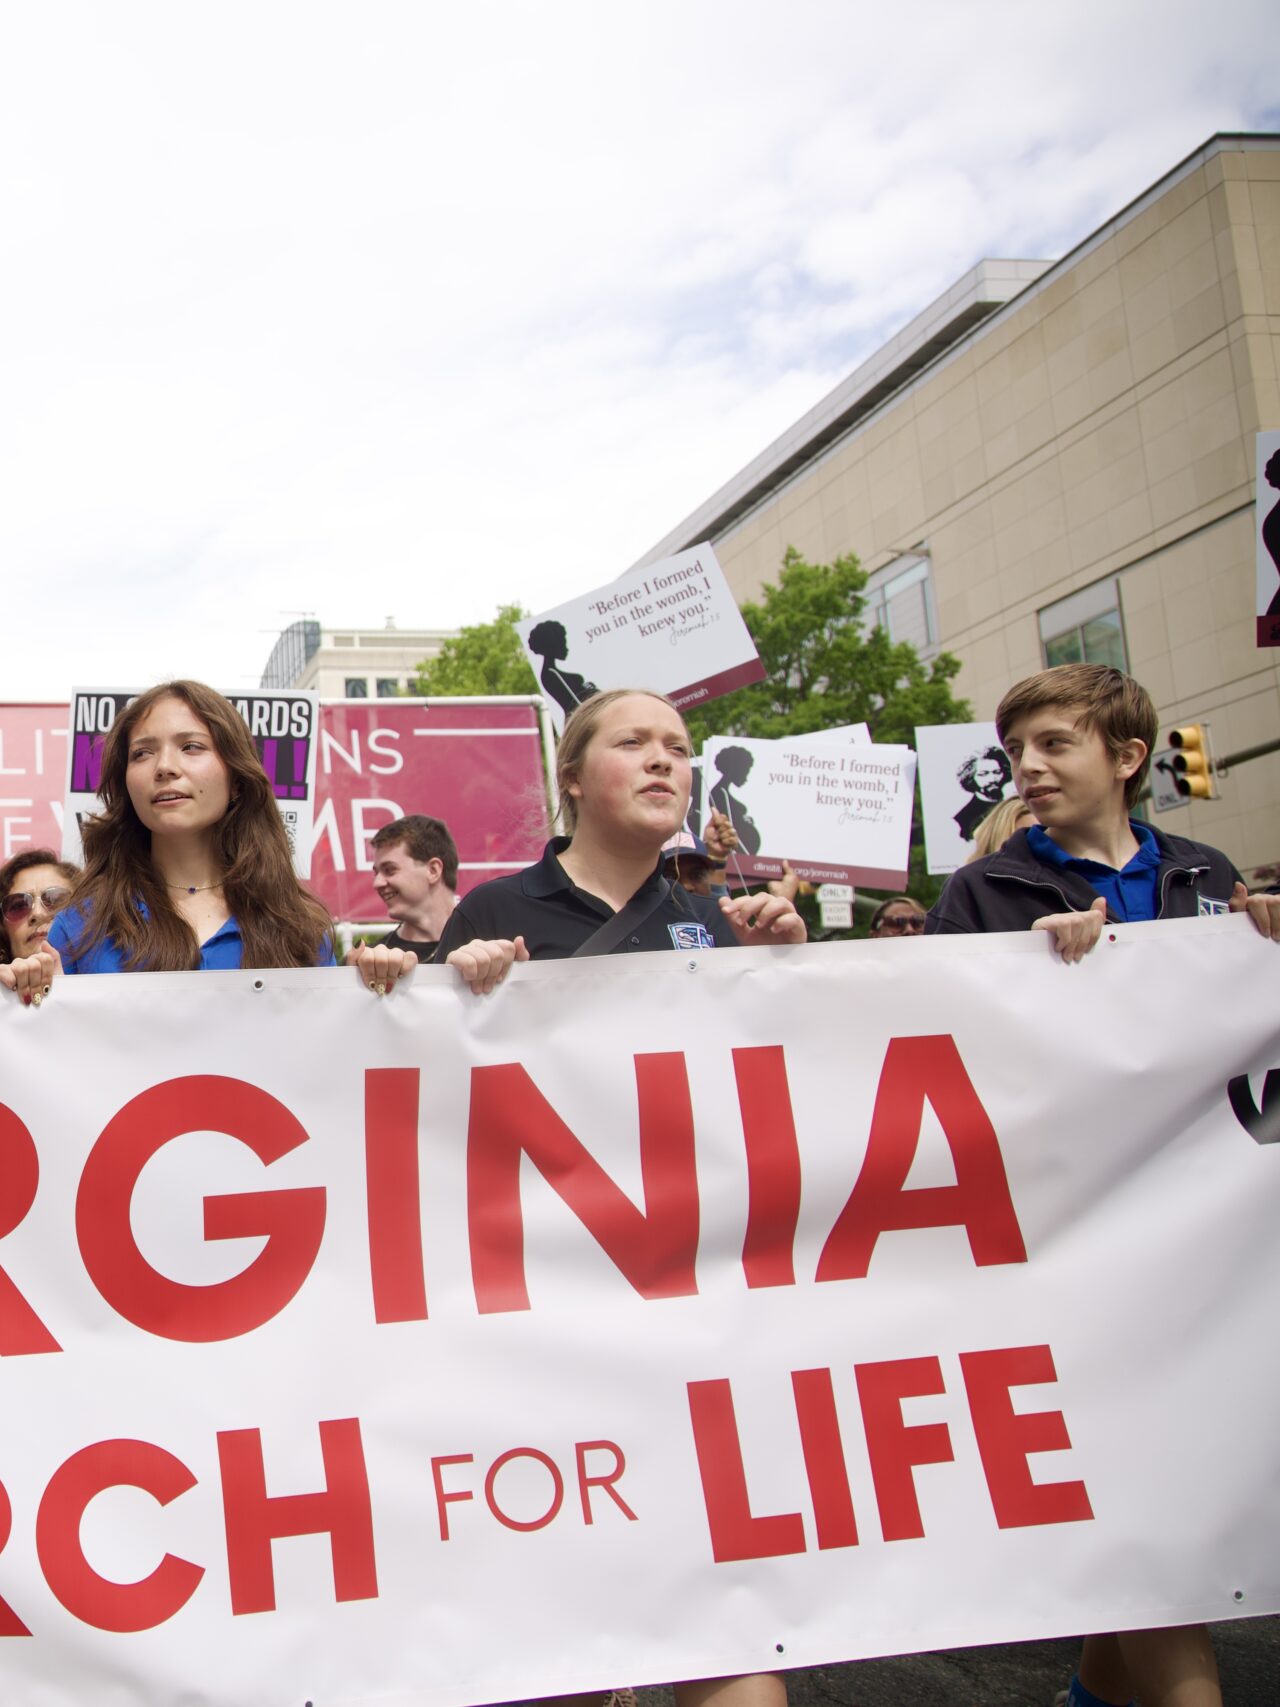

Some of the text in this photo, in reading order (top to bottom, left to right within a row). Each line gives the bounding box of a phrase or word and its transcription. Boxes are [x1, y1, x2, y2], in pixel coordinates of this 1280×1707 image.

[643, 582, 651, 595] I
[653, 560, 704, 591] formed
[585, 576, 711, 643] you in the womb, I
[637, 613, 676, 637] knew
[76, 696, 116, 733] NO
[849, 759, 900, 777] formed
[768, 773, 794, 786] you
[798, 772, 812, 785] in
[816, 774, 840, 788] the
[843, 778, 890, 794] womb,
[816, 791, 854, 807] knew
[432, 1440, 638, 1541] FOR
[687, 1344, 1094, 1564] LIFE
